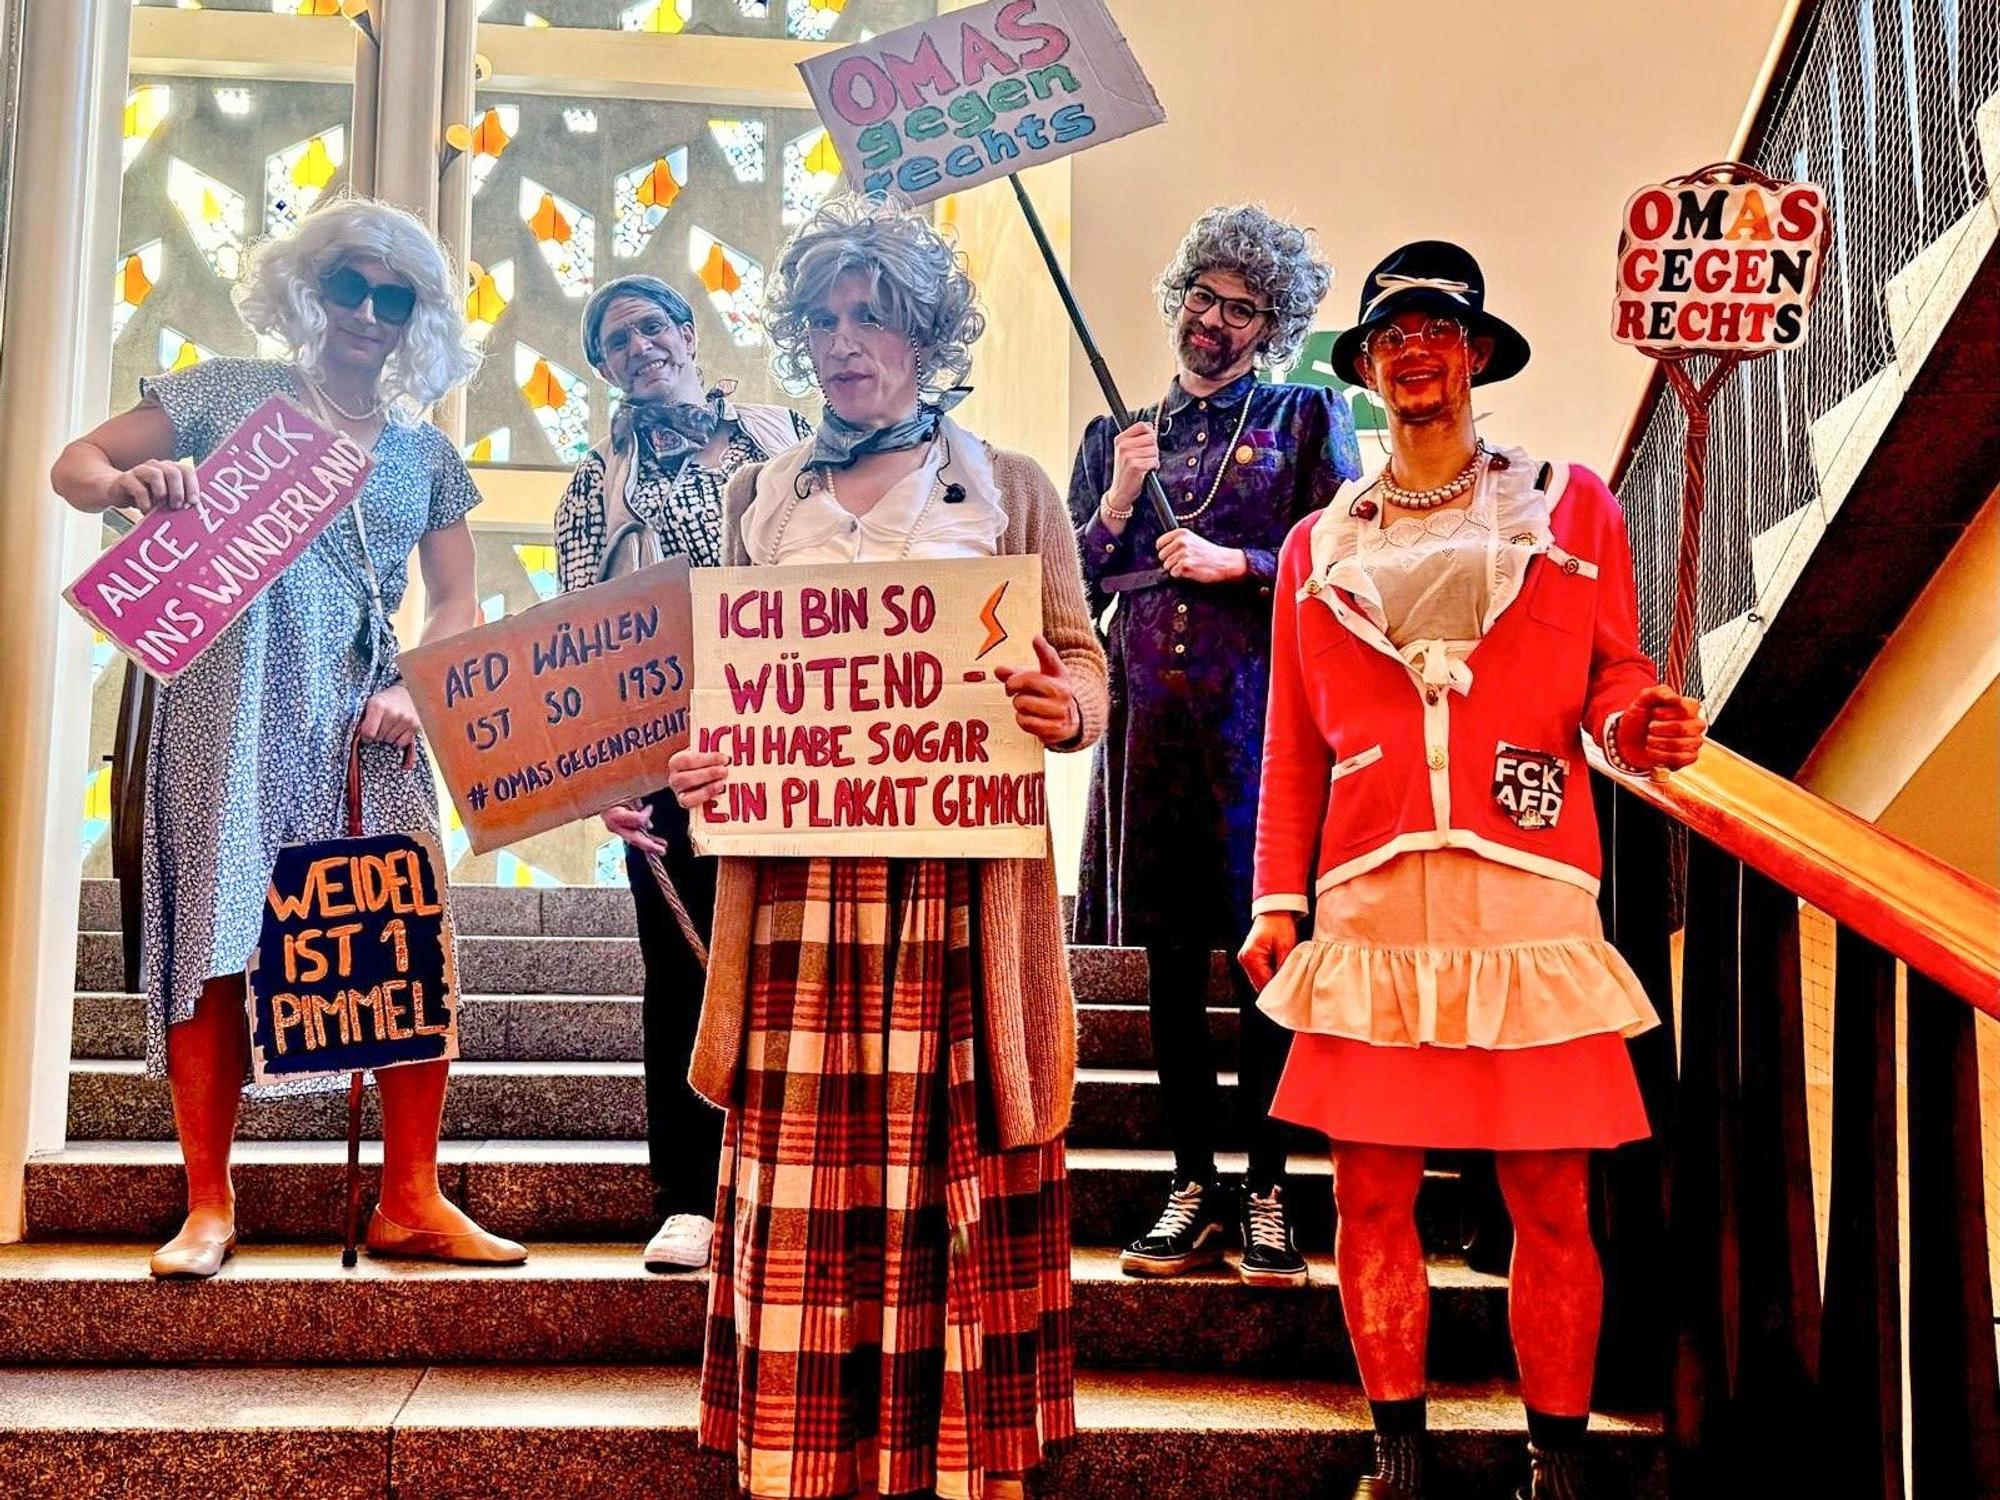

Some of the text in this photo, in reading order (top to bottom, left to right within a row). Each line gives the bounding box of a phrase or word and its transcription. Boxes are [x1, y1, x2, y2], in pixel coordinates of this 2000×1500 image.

[828, 0, 1071, 127] OMAS
[857, 63, 1082, 170] gegen
[863, 104, 1096, 202] rechts
[1629, 189, 1819, 242] OMAS
[1622, 248, 1812, 294] GEGEN
[1616, 300, 1803, 343] RECHTS
[96, 412, 314, 617] ALICE ZURÜCK
[135, 430, 366, 665] INS WUNDERLAND
[719, 584, 936, 639] ICH BIN SO
[445, 604, 659, 708] AFD WÄHLEN
[724, 651, 943, 715] WÜTEND
[466, 655, 685, 750] IST SO 1933
[699, 719, 990, 767] ICH HABE SOGAR
[1495, 757, 1562, 793] FCK
[703, 771, 1045, 828] EIN PLAKAT GEMACHT
[1496, 784, 1563, 816] AFD
[267, 849, 442, 922] WEIDEL
[284, 918, 408, 983] IST 1
[271, 979, 446, 1055] PIMMEL
